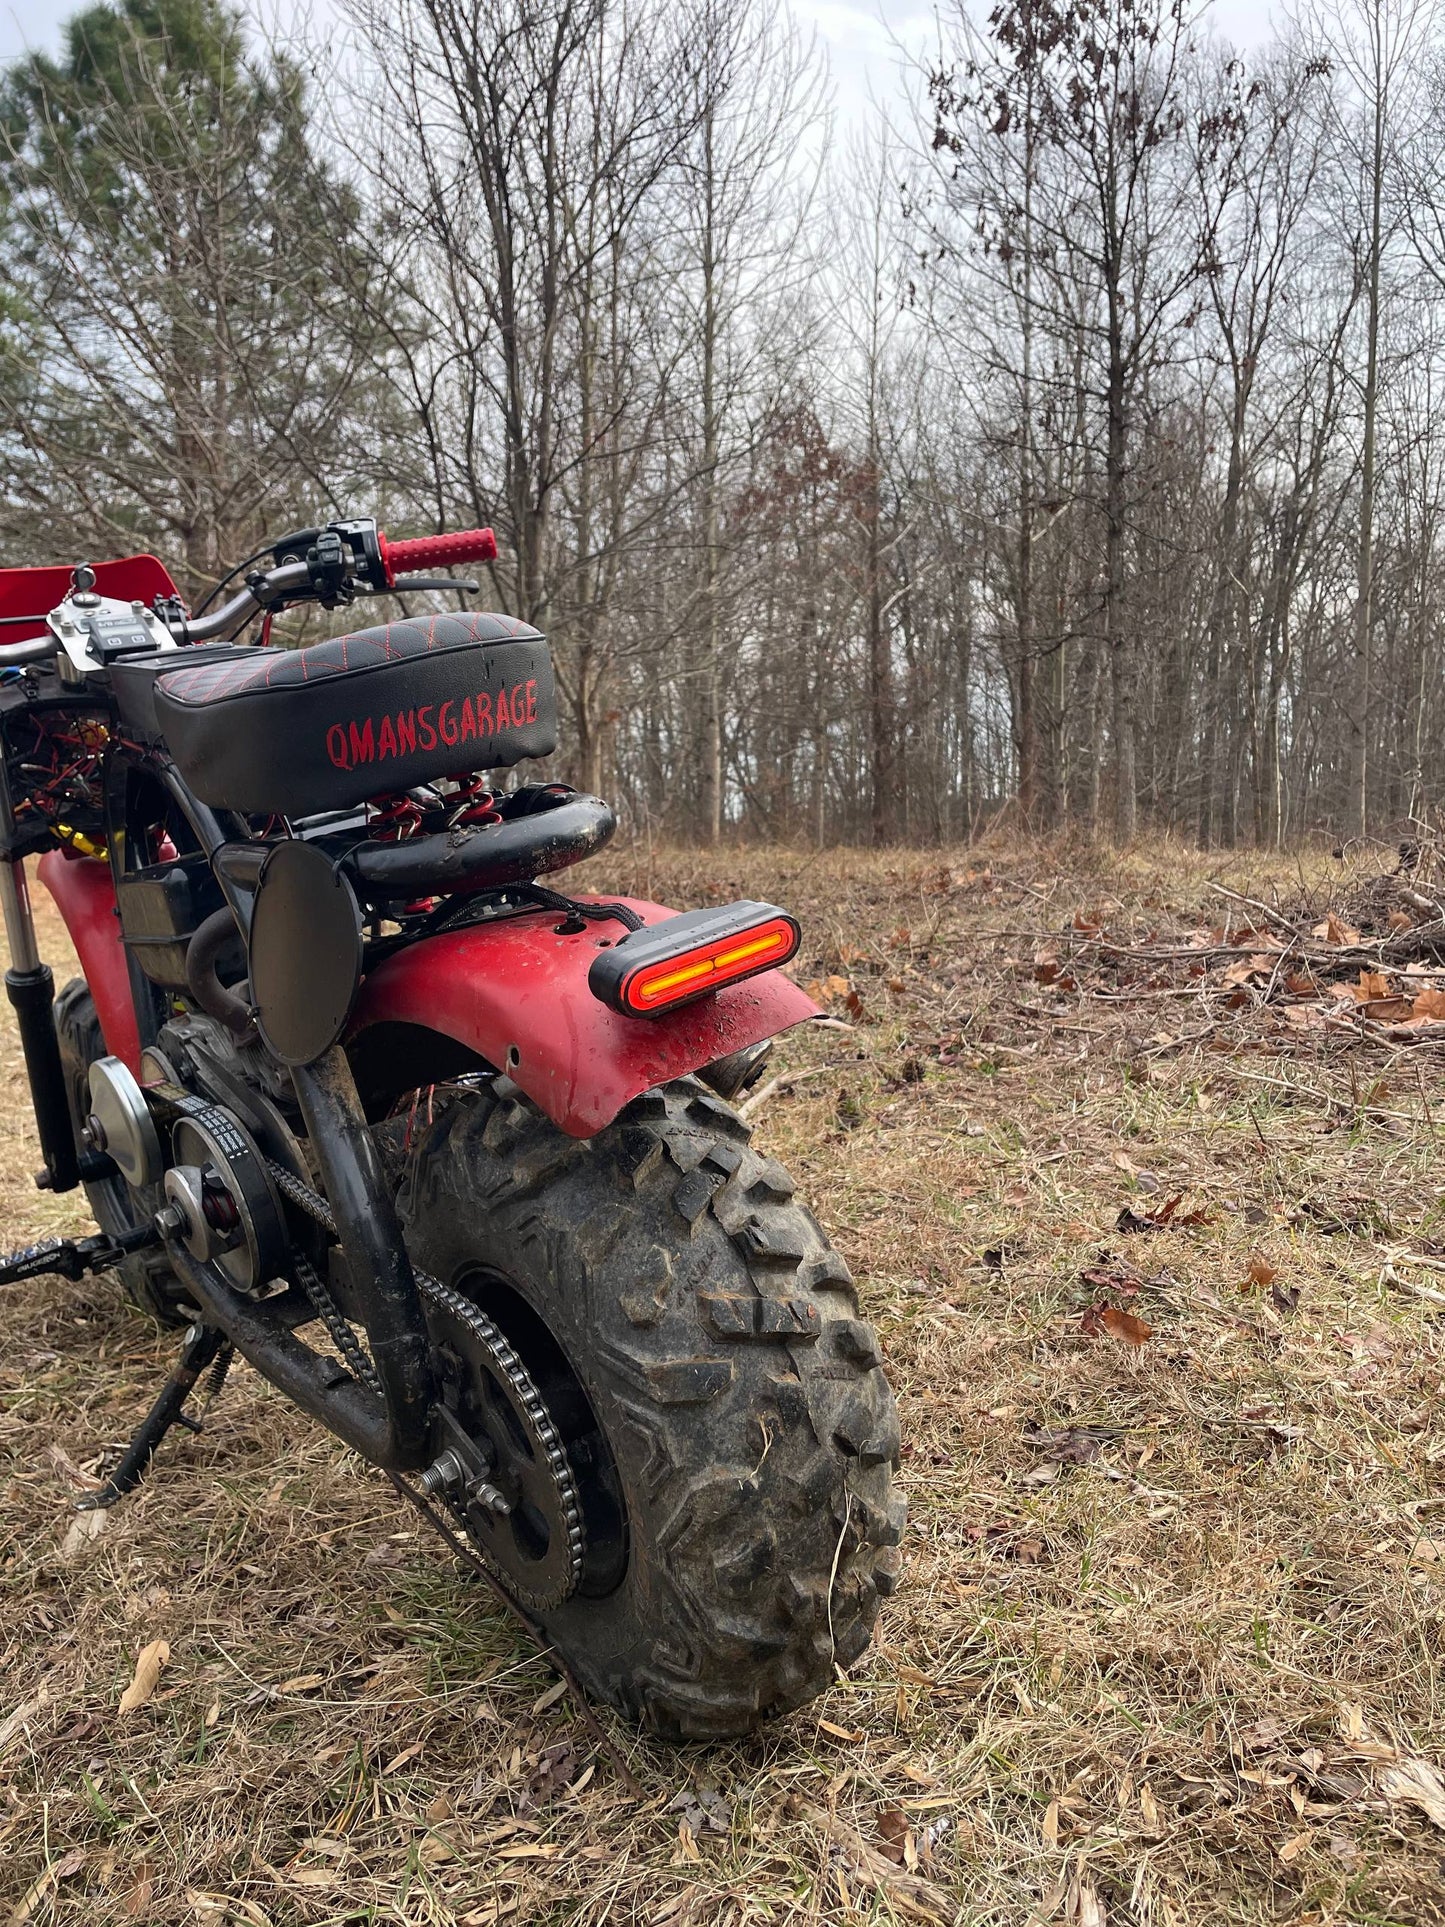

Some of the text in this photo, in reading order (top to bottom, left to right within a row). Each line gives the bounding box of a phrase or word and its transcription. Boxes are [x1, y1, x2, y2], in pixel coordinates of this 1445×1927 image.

[326, 679, 537, 771] QMANSGARAGE
[216, 1134, 232, 1154] ENGINE
[223, 1132, 239, 1151] ENGINE
[230, 1129, 246, 1147] ENGINE
